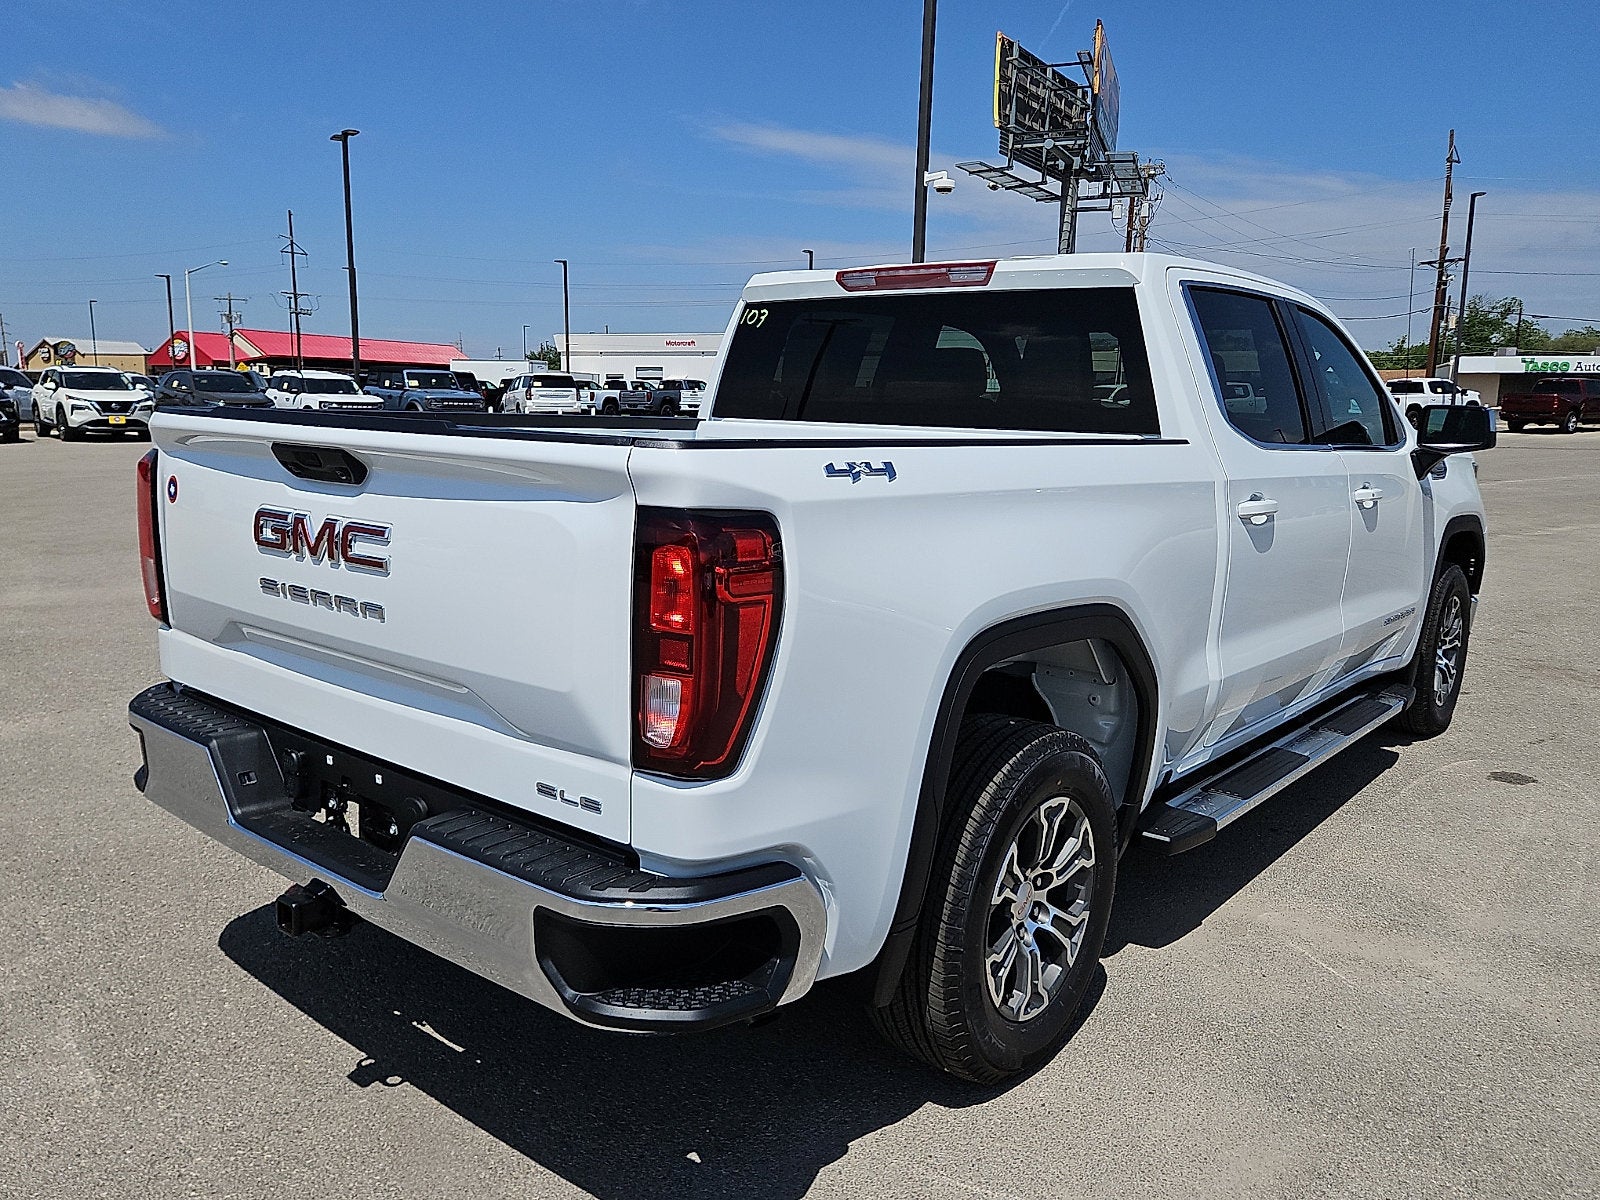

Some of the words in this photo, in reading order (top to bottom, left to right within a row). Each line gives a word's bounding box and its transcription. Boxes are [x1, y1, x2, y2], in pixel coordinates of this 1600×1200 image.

[740, 309, 769, 328] 103
[1521, 358, 1570, 371] TASCO
[253, 503, 393, 577] GMC
[258, 577, 386, 623] SIERRA
[536, 782, 603, 815] SLE
